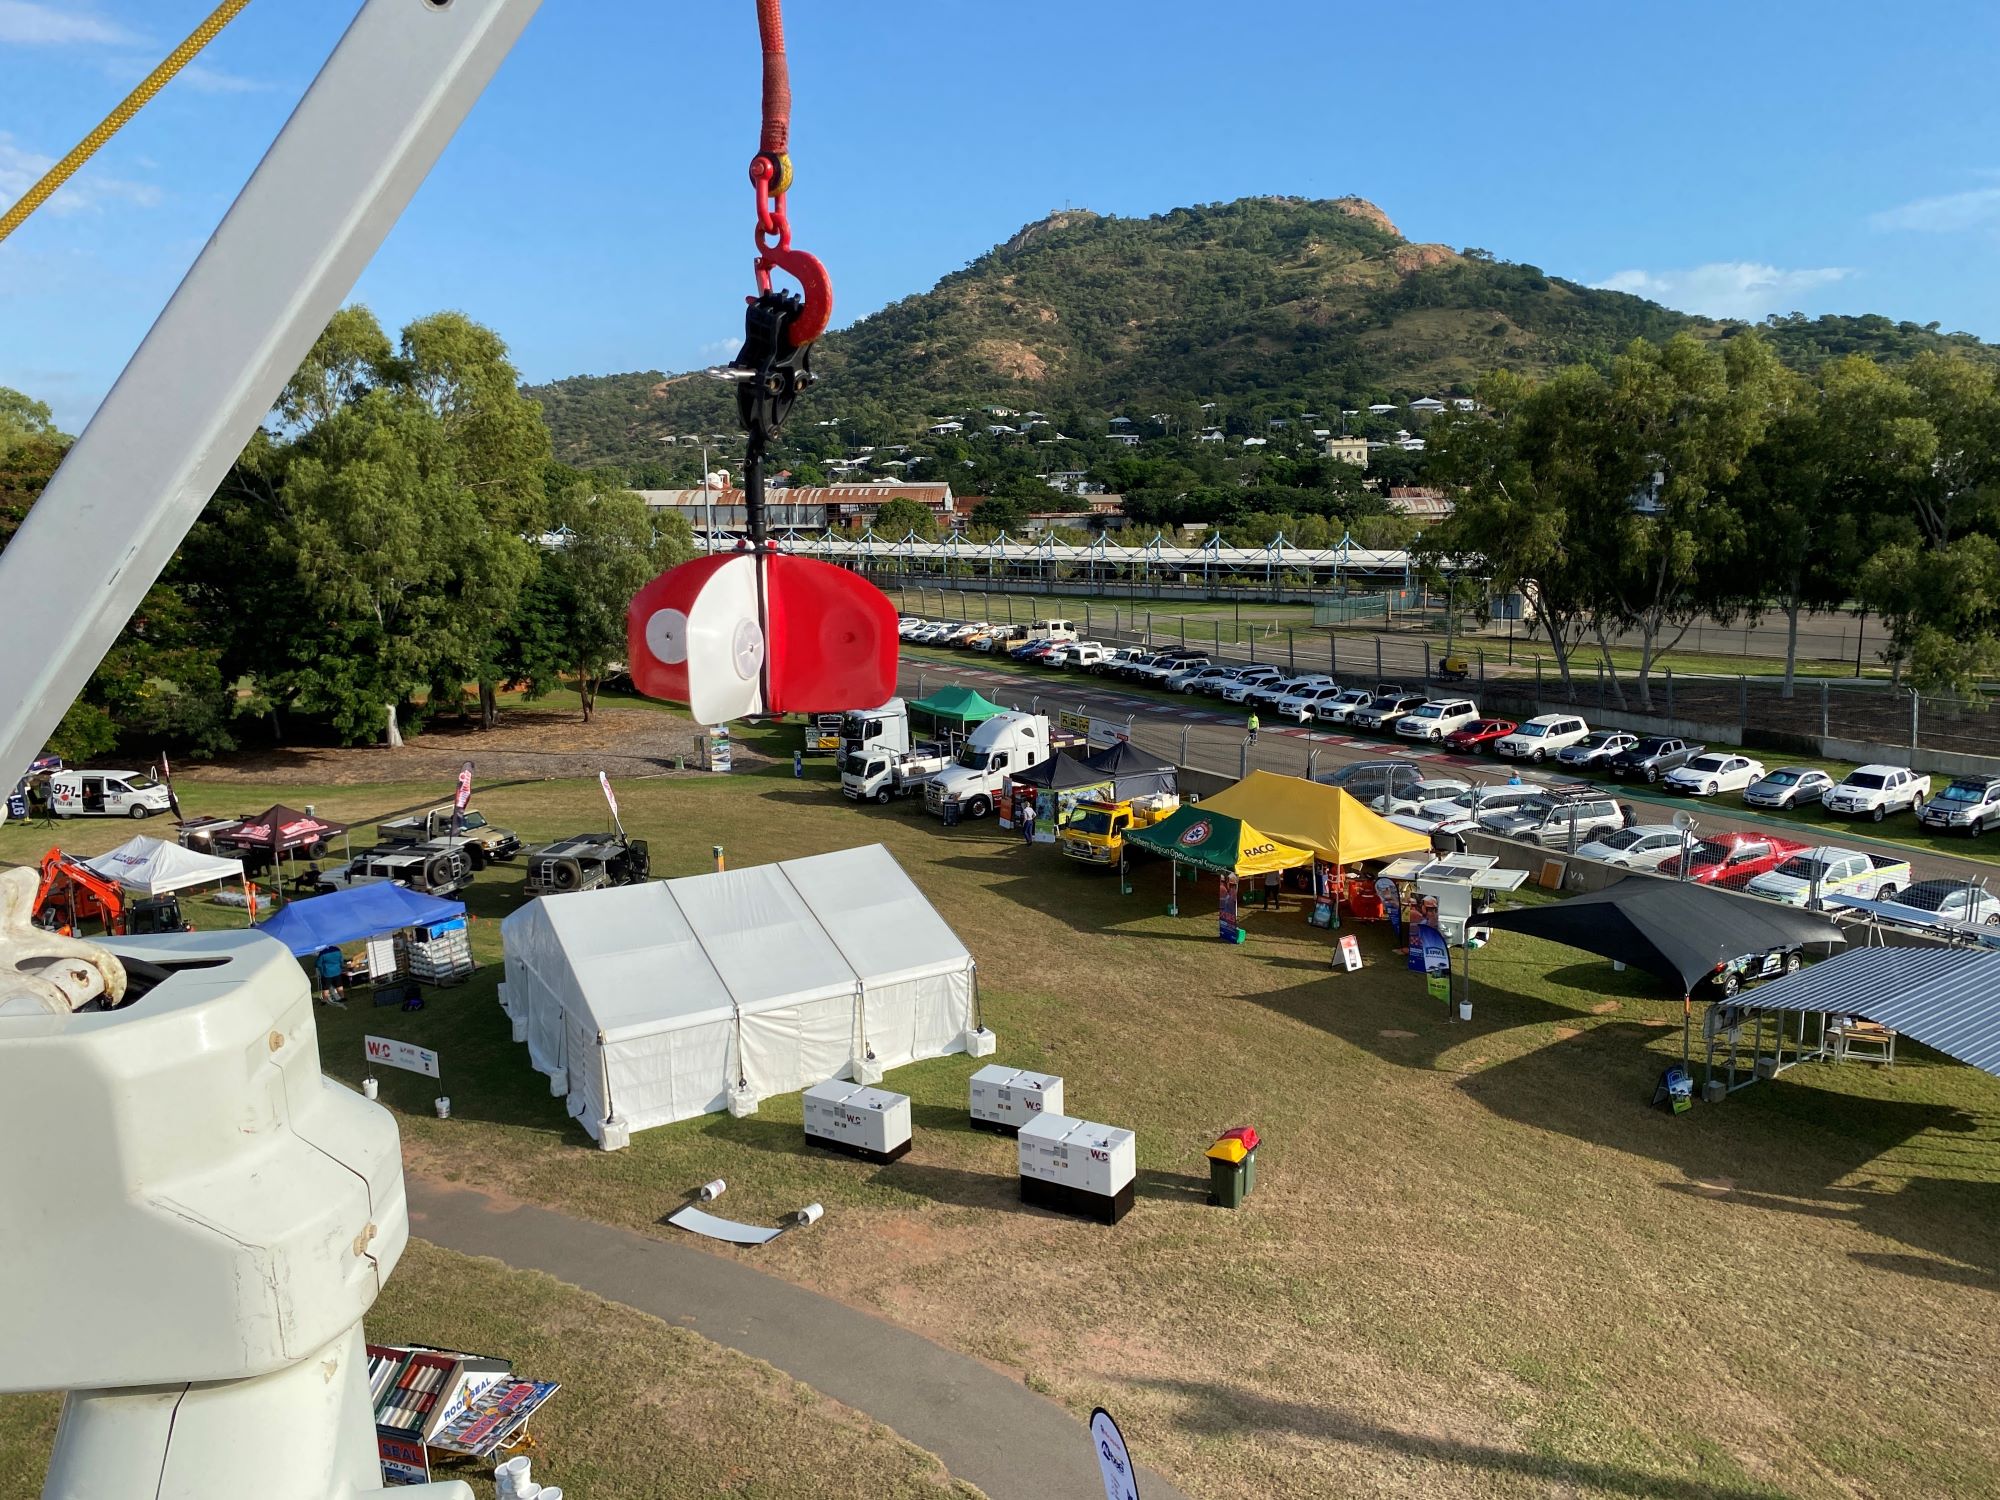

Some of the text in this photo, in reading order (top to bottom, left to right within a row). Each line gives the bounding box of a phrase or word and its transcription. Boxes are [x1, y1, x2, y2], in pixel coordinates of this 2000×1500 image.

[1150, 841, 1170, 856] Region
[1170, 848, 1204, 866] Operational
[1243, 843, 1275, 858] RACQ
[470, 1377, 491, 1400] SEAL
[382, 1443, 420, 1464] SEAL
